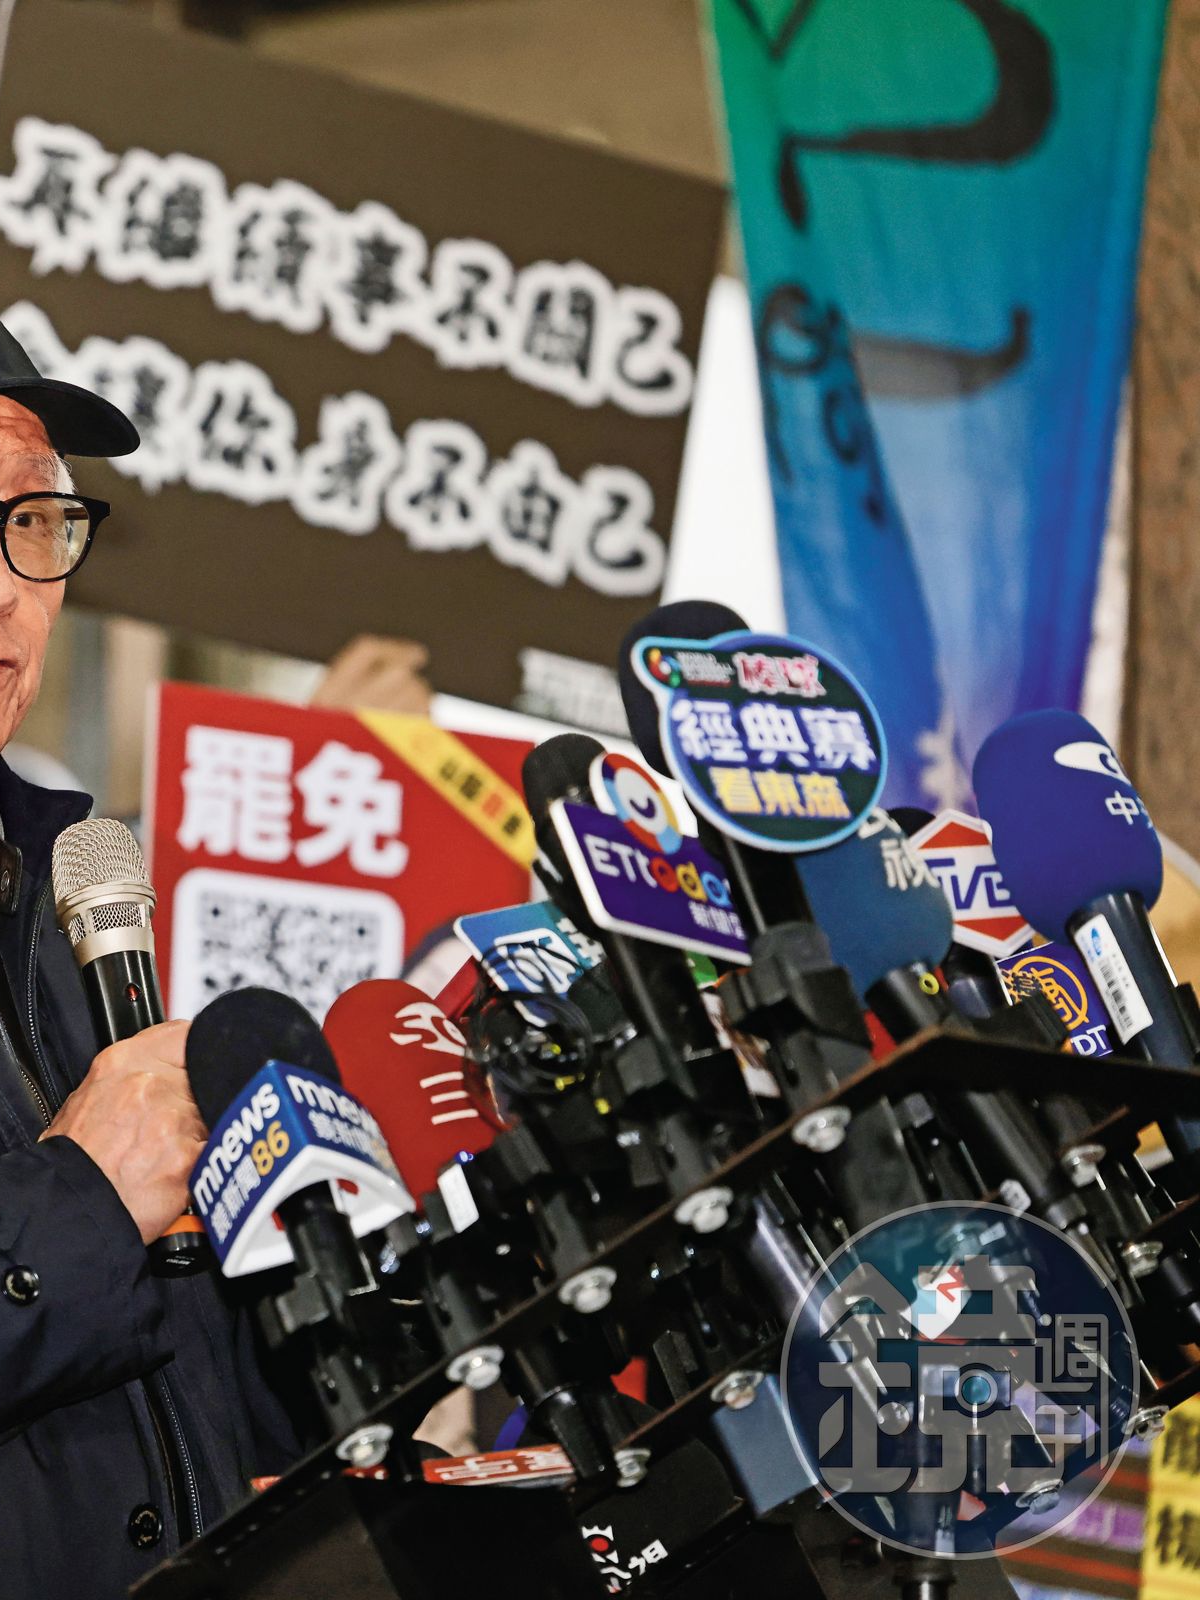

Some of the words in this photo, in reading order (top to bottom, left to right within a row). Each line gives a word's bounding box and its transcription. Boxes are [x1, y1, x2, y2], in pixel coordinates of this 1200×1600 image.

[0, 298, 666, 598] 讓你身不由己
[671, 699, 876, 771] 經典賽
[179, 724, 408, 877] 罷免
[583, 832, 733, 908] ETtoda
[194, 1083, 280, 1216] mnews
[251, 1120, 290, 1177] 86
